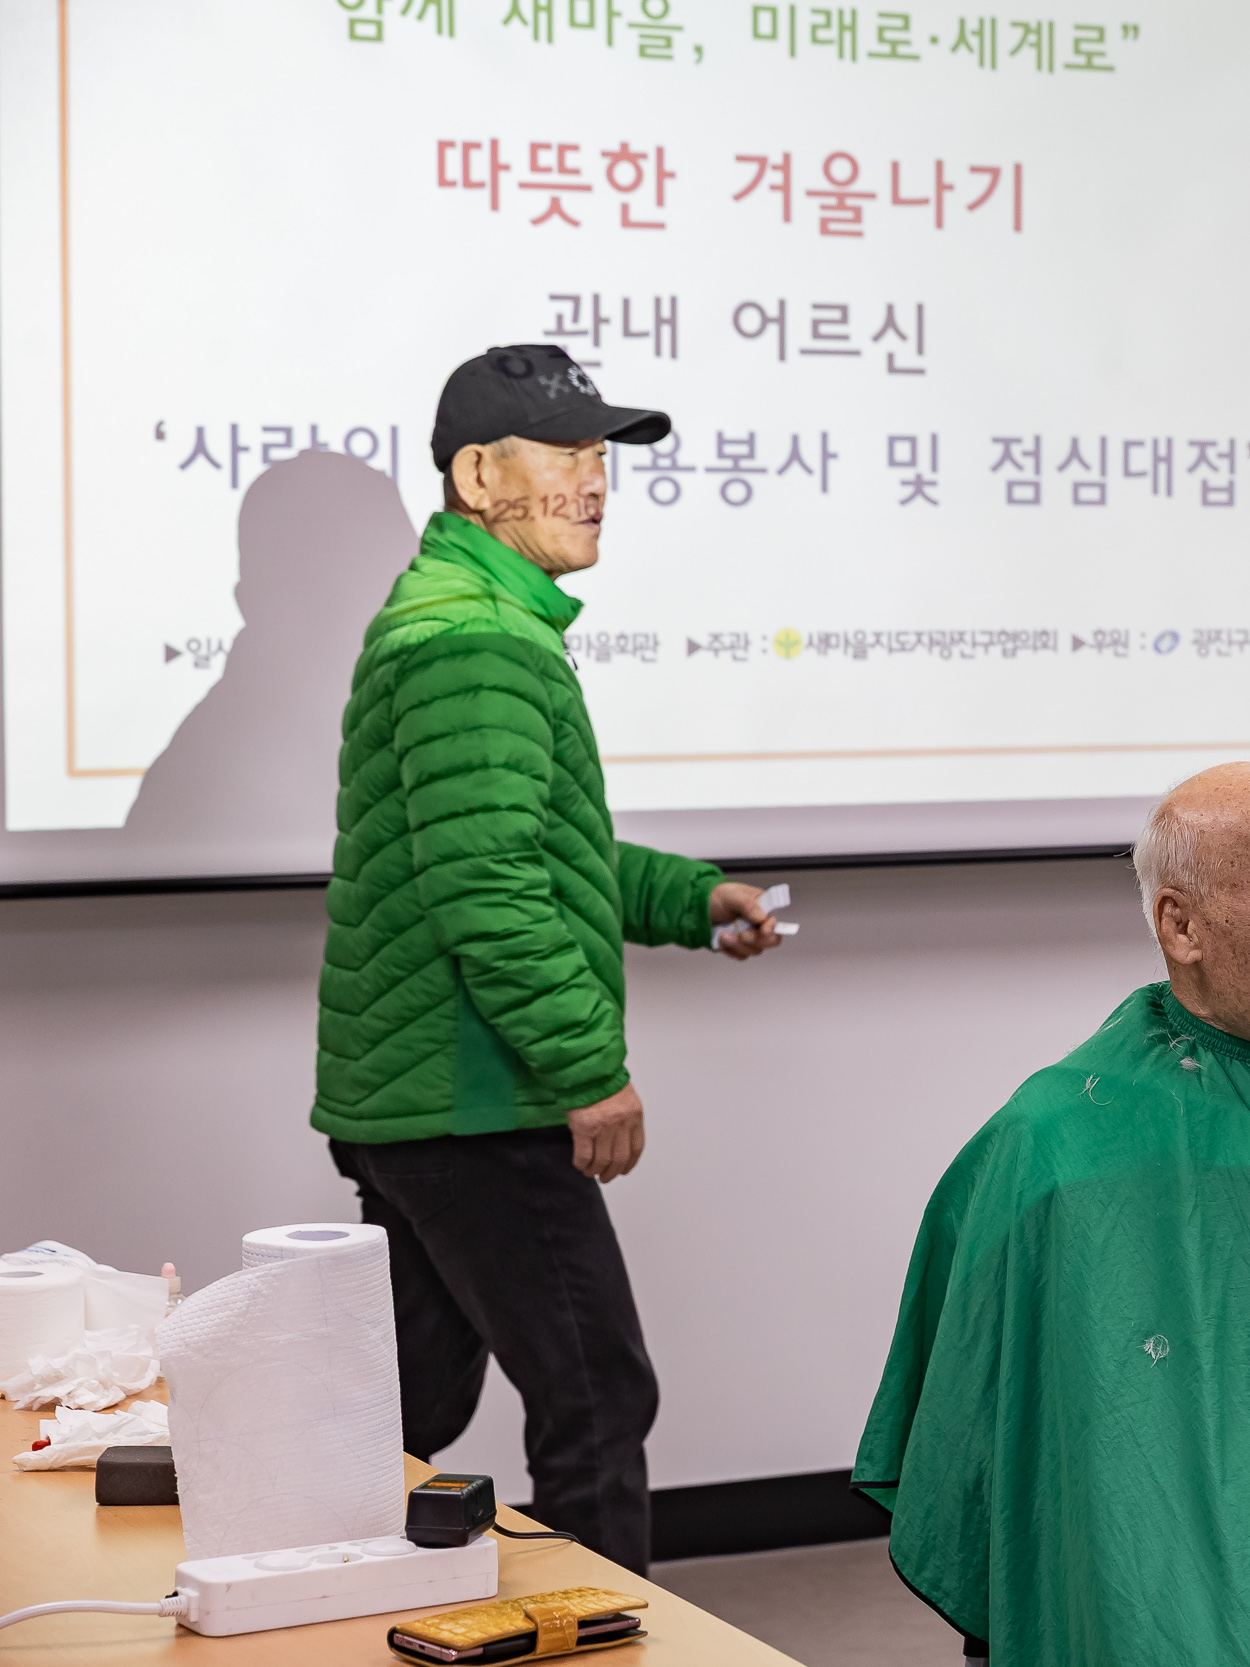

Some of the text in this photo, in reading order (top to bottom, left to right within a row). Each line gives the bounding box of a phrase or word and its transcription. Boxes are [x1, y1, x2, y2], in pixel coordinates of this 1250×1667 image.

[502, 0, 704, 64] 새마을,
[436, 138, 1024, 239] 따뜻한 겨울나기
[543, 292, 927, 375] 관내 어르신
[886, 432, 940, 506] 및
[706, 631, 751, 662] 주관
